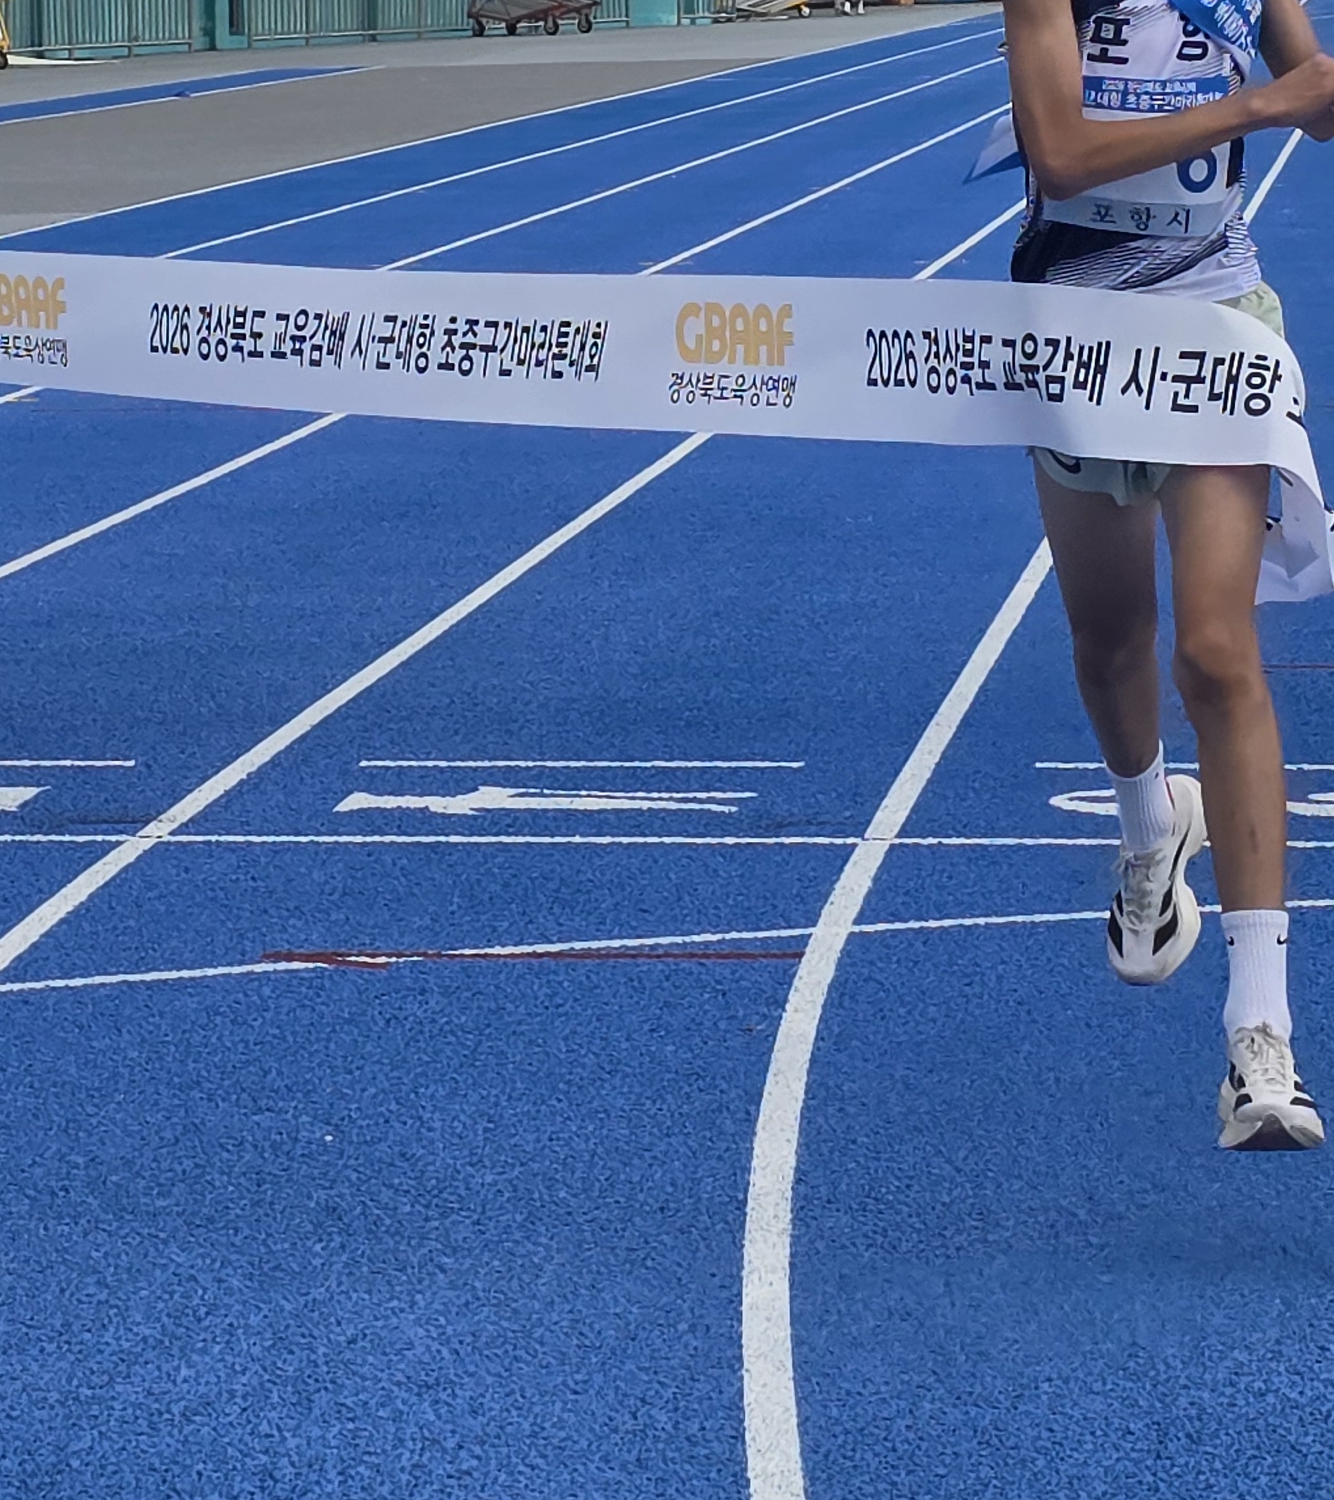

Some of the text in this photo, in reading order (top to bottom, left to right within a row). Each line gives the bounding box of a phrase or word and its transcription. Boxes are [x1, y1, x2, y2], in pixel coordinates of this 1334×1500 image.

[149, 301, 191, 355] 2026
[195, 303, 267, 364] 경상북도
[269, 308, 350, 370] 교육감배
[436, 314, 609, 384] 초중구간마라톤대회
[674, 301, 795, 367] GBAAF
[864, 325, 920, 391] 2026
[920, 325, 998, 399] 경상북도
[1000, 330, 1113, 408] 교육감배
[666, 370, 798, 411] 경상북도육상연맹
